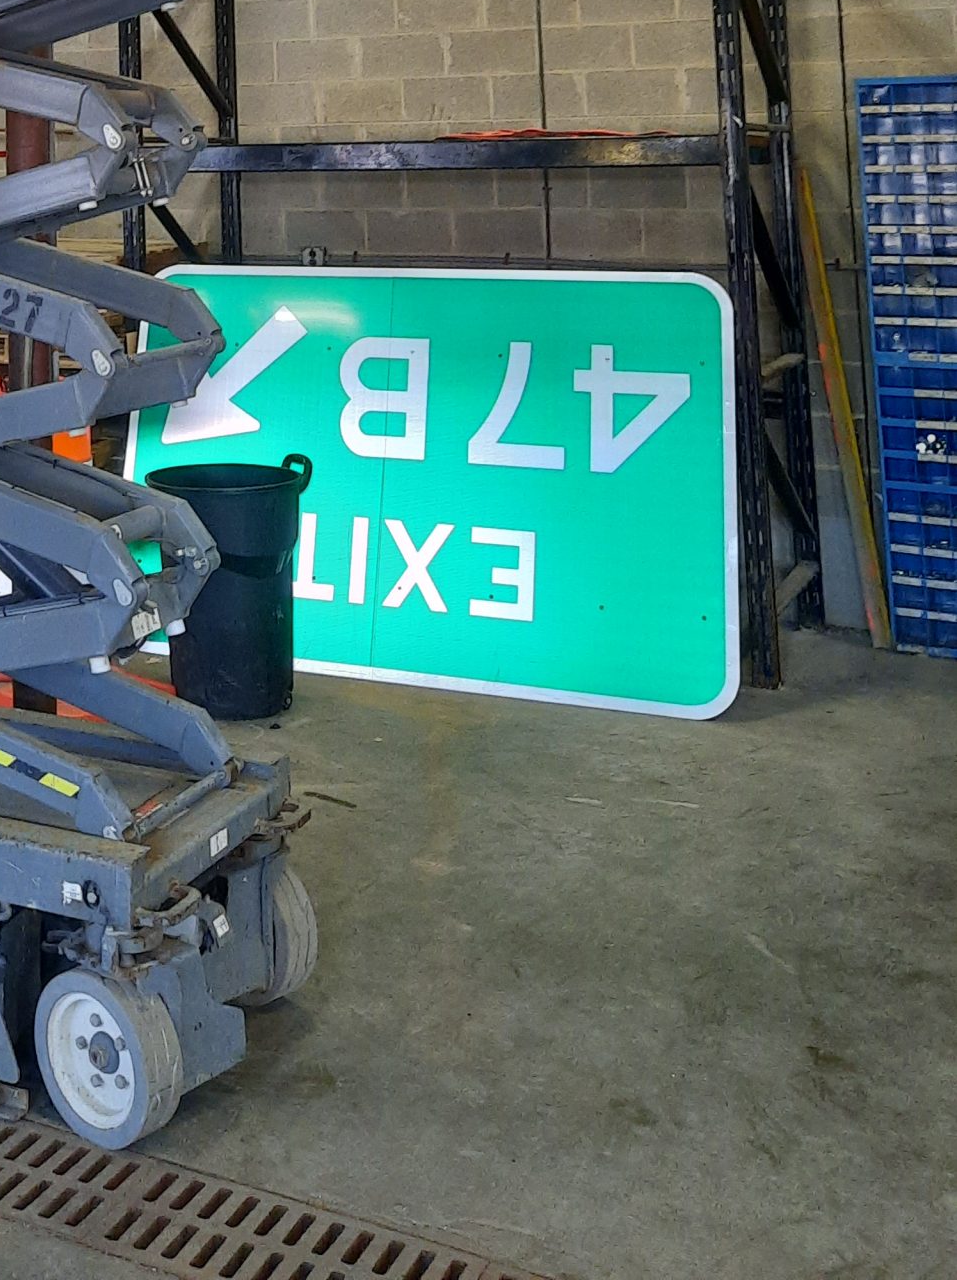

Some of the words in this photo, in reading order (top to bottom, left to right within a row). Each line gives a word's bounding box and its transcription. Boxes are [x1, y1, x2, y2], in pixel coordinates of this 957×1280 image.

[340, 336, 431, 461] B
[468, 341, 691, 474] 47
[292, 512, 537, 623] EXIT
